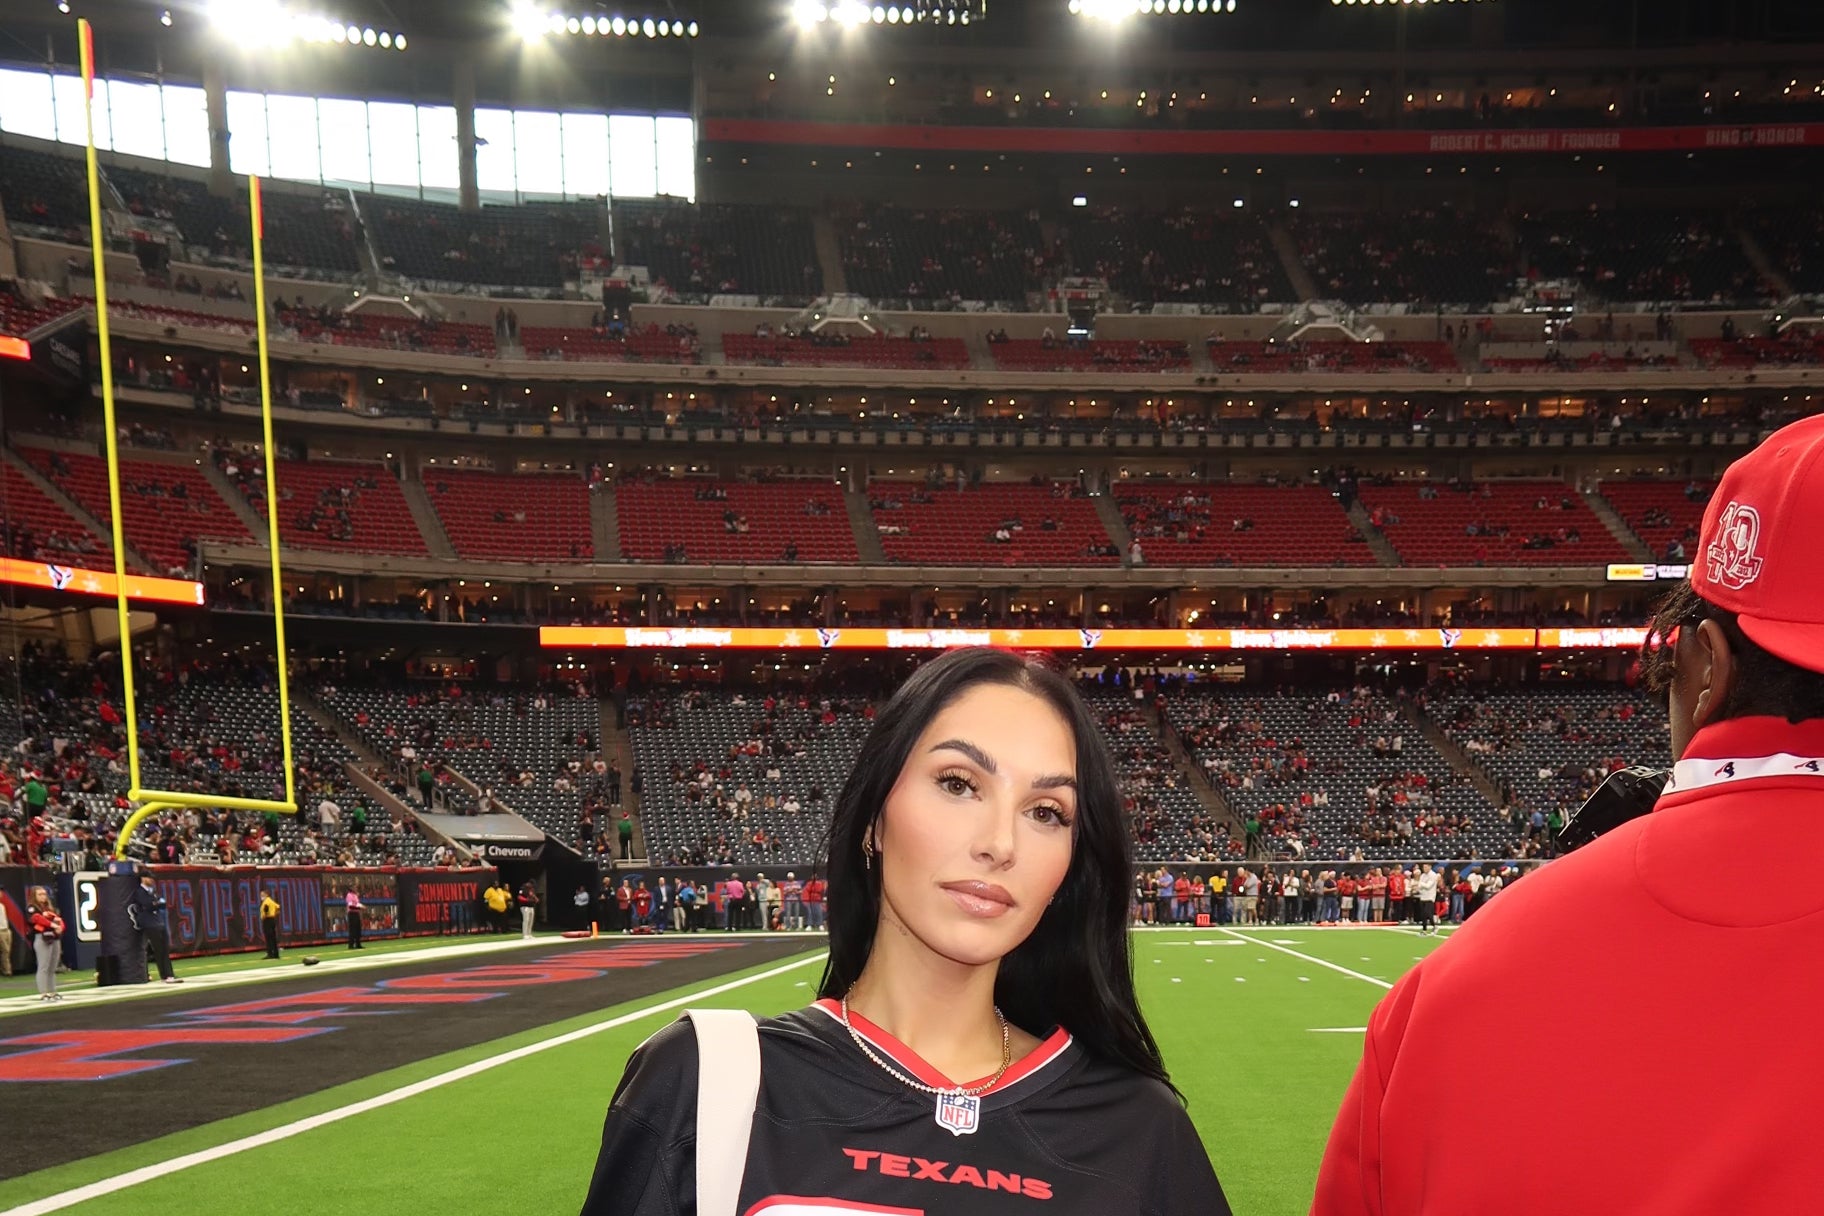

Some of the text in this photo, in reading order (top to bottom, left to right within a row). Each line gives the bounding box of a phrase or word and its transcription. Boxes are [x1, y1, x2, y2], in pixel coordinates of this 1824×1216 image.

[1430, 134, 1479, 151] ROBERT
[1484, 134, 1497, 150] C.
[1562, 131, 1620, 148] FOUNDER
[1706, 129, 1739, 145] RING
[1757, 128, 1806, 144] HONOR
[488, 845, 531, 857] Chevron
[418, 881, 479, 903] COMMUNITY
[200, 878, 233, 942] UP
[943, 1105, 972, 1126] NFL
[842, 1147, 1054, 1200] TEXANS
